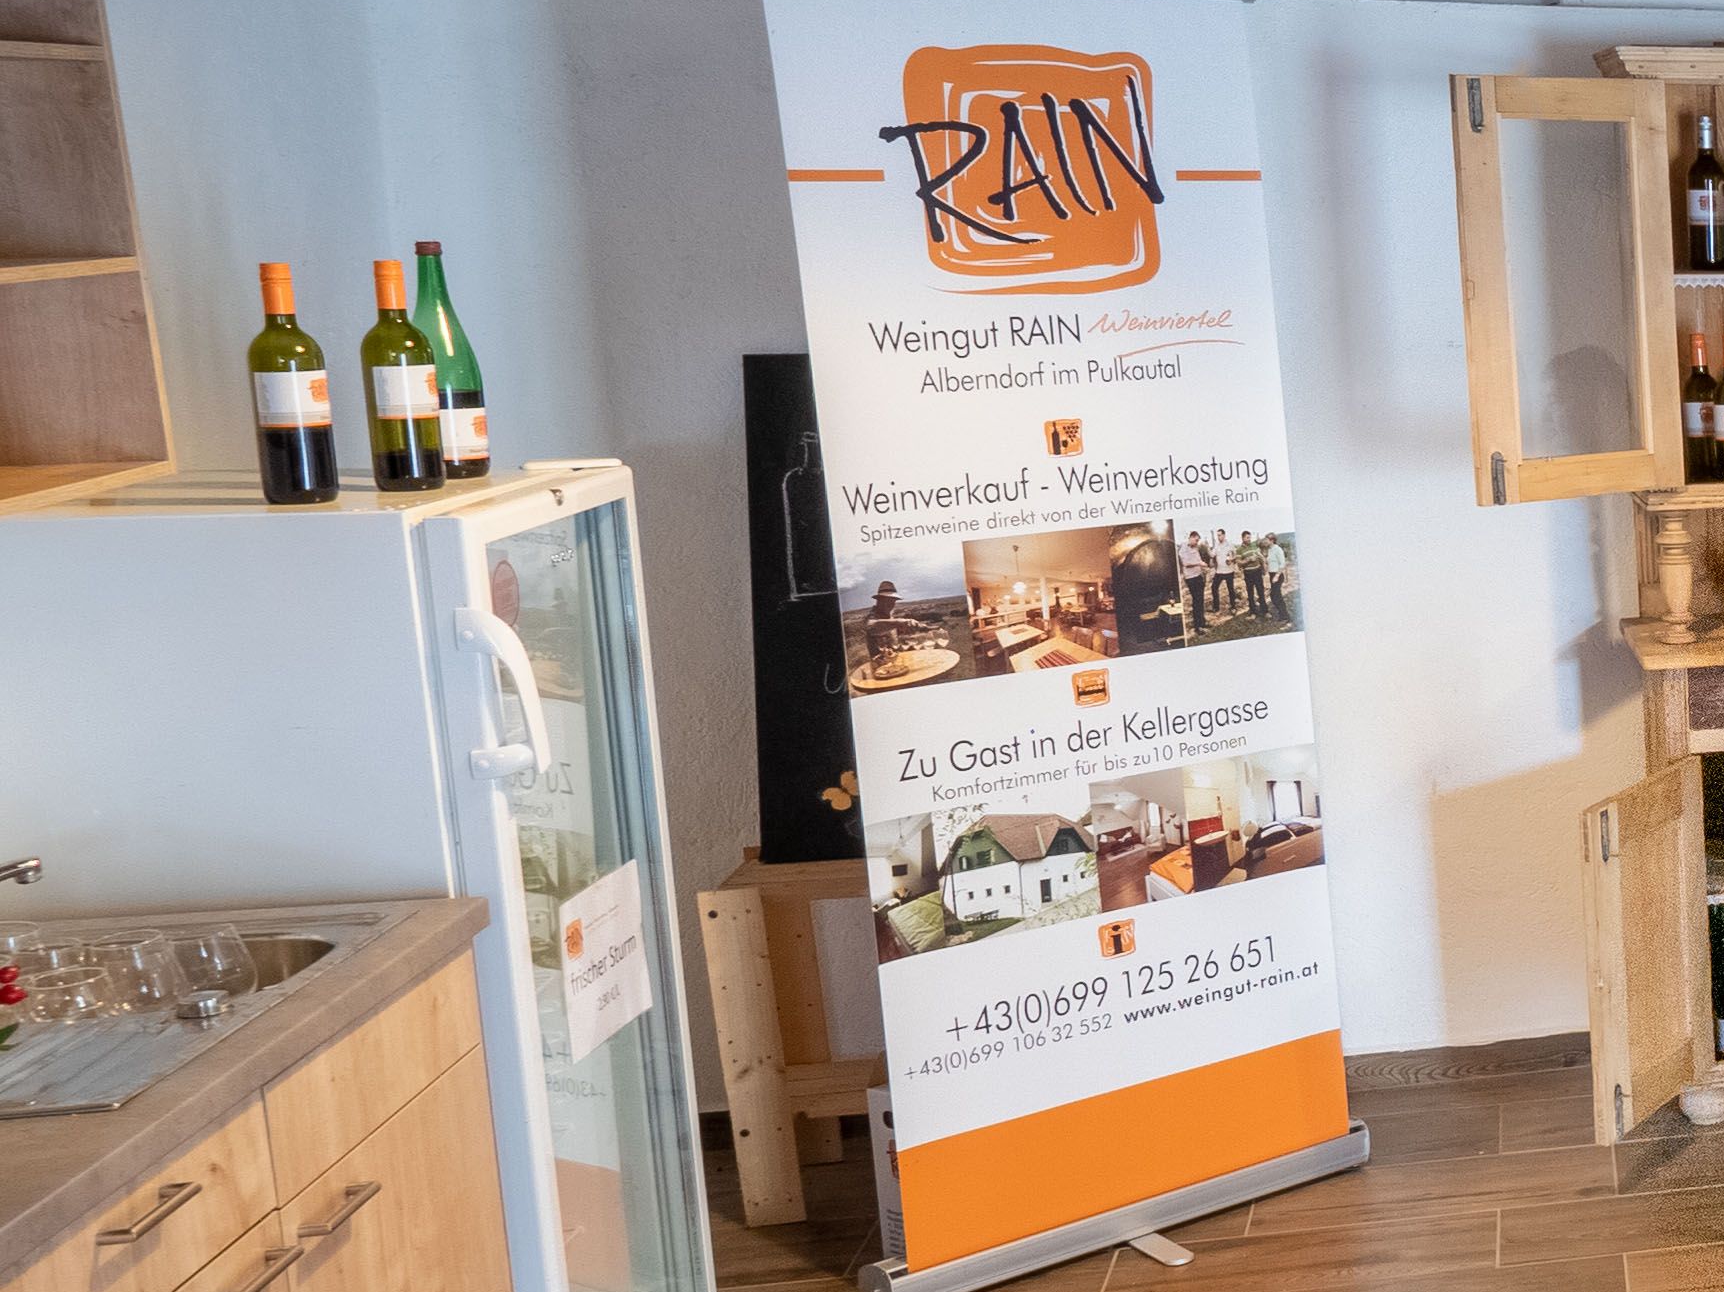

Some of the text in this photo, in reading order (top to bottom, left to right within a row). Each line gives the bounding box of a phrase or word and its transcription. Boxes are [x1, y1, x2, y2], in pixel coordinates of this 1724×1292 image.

[879, 75, 1165, 244] RAIN
[868, 309, 1234, 359] Weingut RAIN Weinviertel
[920, 354, 1182, 394] Alberndorf im Pulkautal
[842, 467, 1030, 516] Weinverkauf
[1058, 455, 1269, 495] Weinverkostung
[860, 488, 1260, 546] Spitzenweine direkt von der Winzerfamilie Rain
[898, 699, 1269, 782] Zu Gast in der Kellergasse
[932, 766, 1069, 803] Komfortzimmer
[1074, 759, 1098, 777] für
[1104, 753, 1128, 772] bis
[1179, 734, 1247, 758] Personen
[570, 934, 638, 996] frischer Sturm
[946, 935, 1277, 1042] +43(0)699 125 26 651
[904, 961, 1320, 1080] +43(0)699 106 32 552 www.weingut-rain.at
